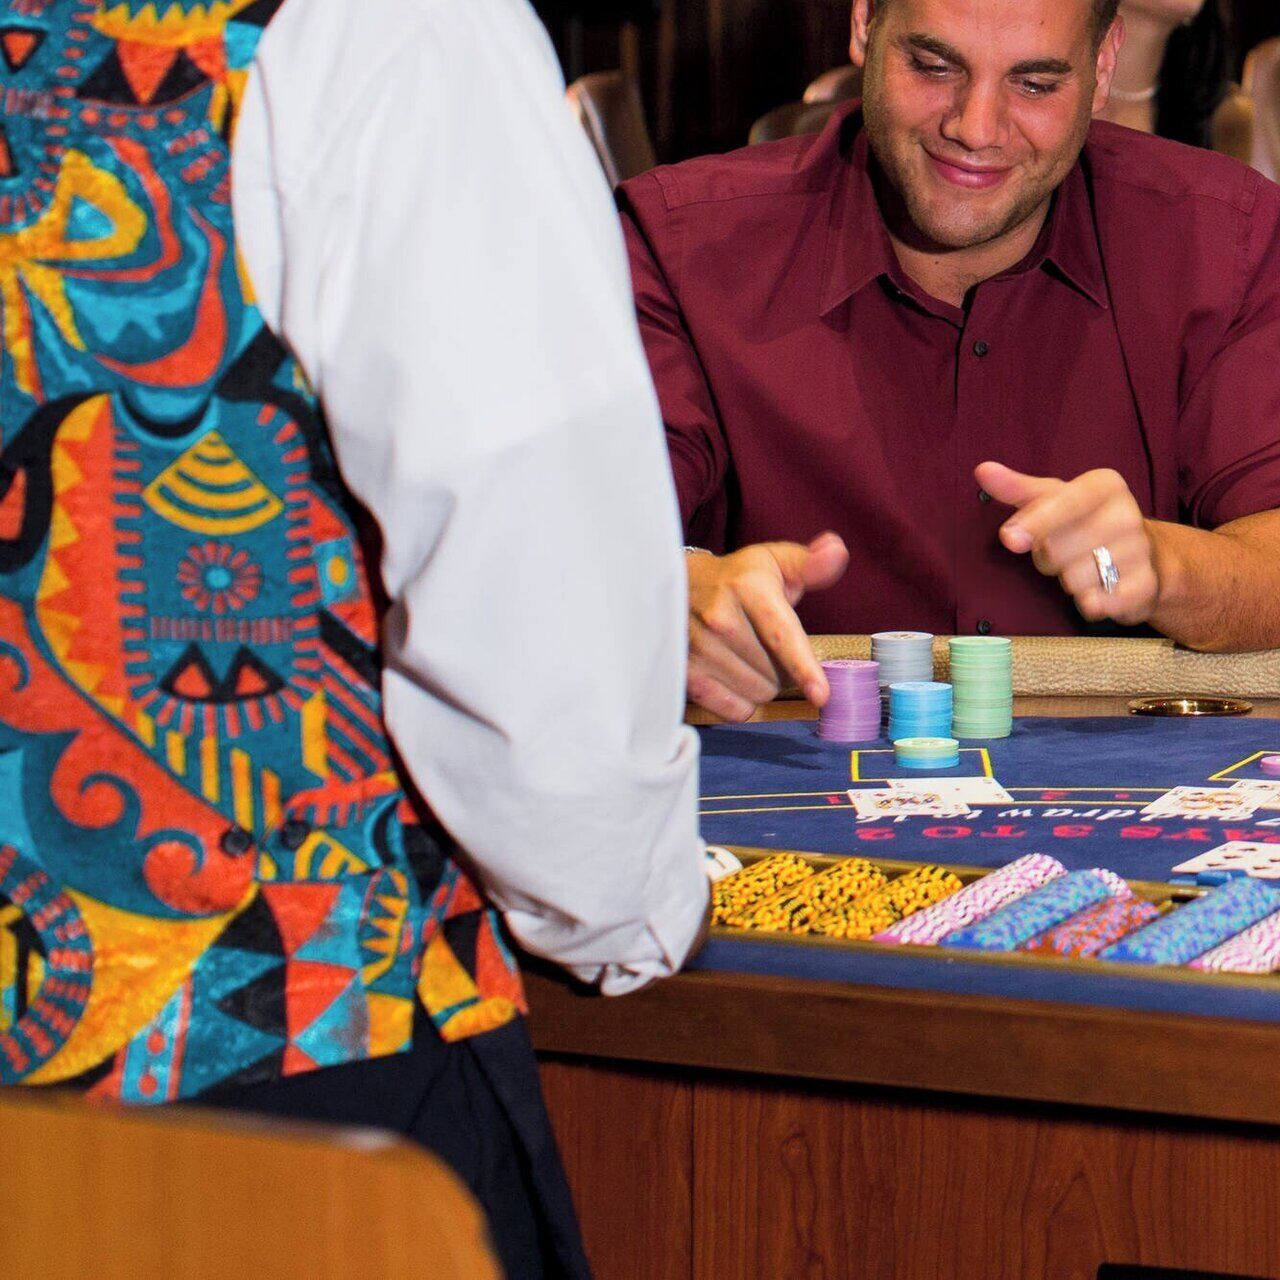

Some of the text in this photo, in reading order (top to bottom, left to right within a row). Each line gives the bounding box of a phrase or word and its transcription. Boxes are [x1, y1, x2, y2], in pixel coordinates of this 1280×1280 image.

[997, 807, 1137, 821] draw
[854, 826, 897, 841] 2
[921, 823, 1027, 840] TO
[1052, 823, 1094, 839] 3
